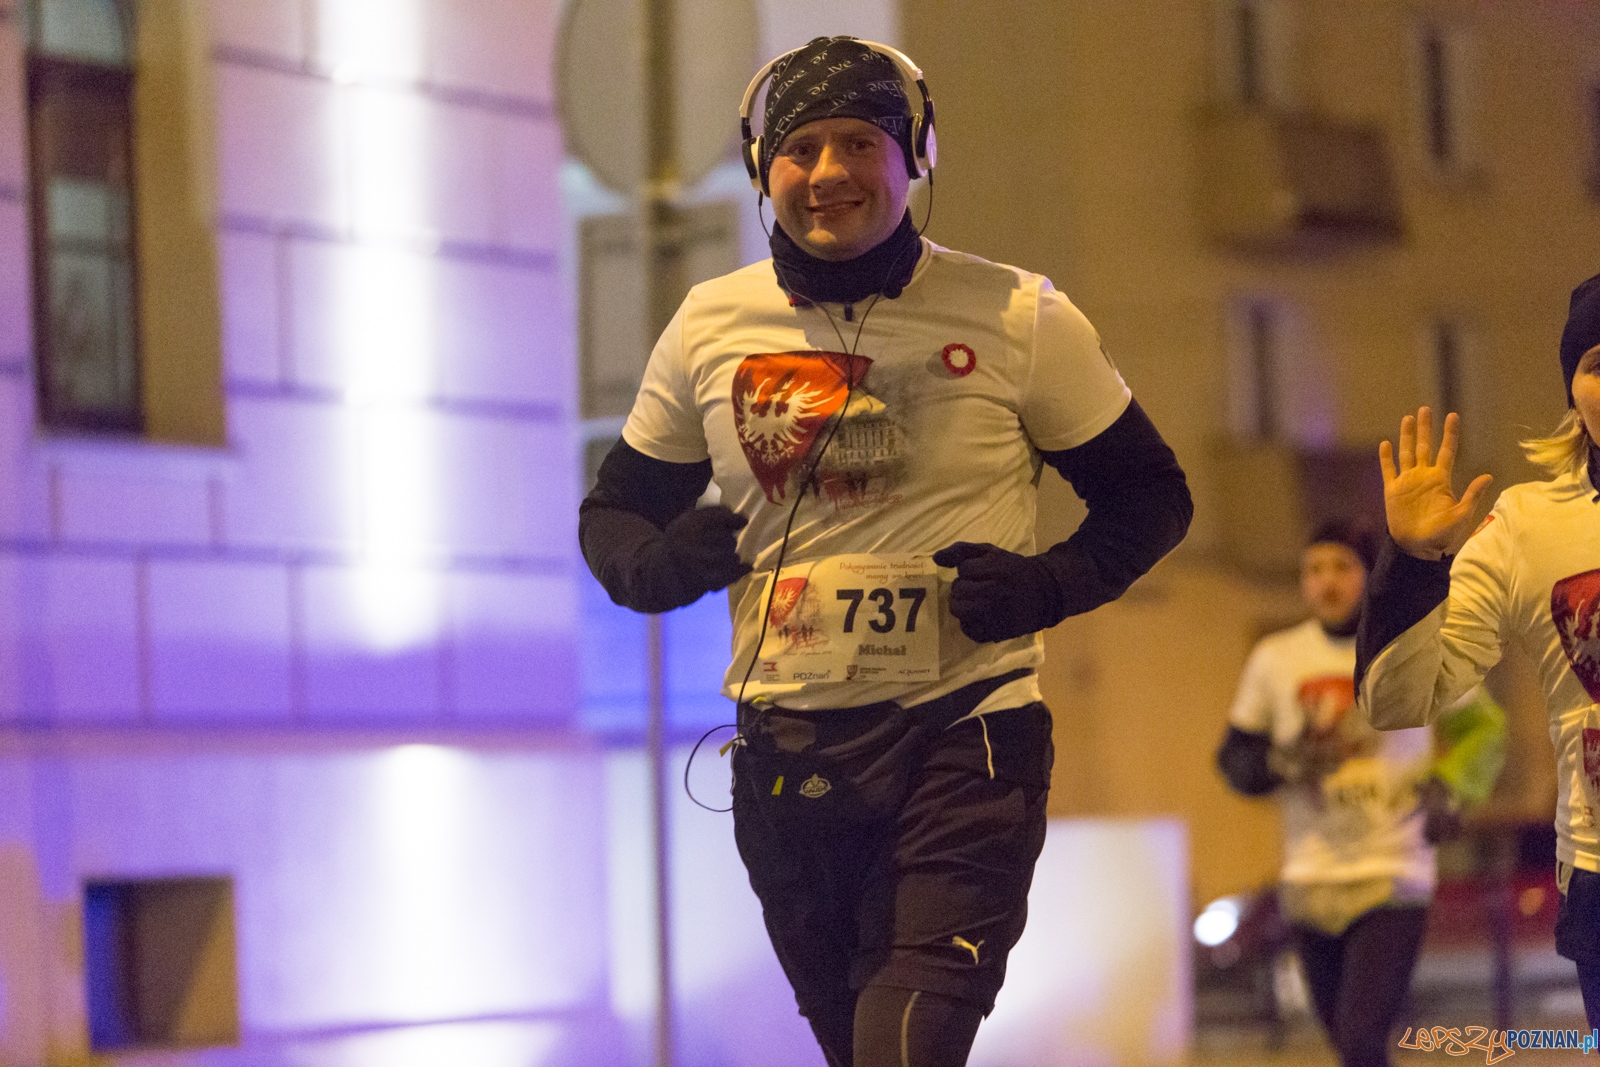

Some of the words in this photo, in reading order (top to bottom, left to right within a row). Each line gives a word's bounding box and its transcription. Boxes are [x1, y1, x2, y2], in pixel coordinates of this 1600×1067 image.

[865, 573, 889, 584] mamy
[836, 587, 927, 634] 737
[858, 643, 907, 656] Michał
